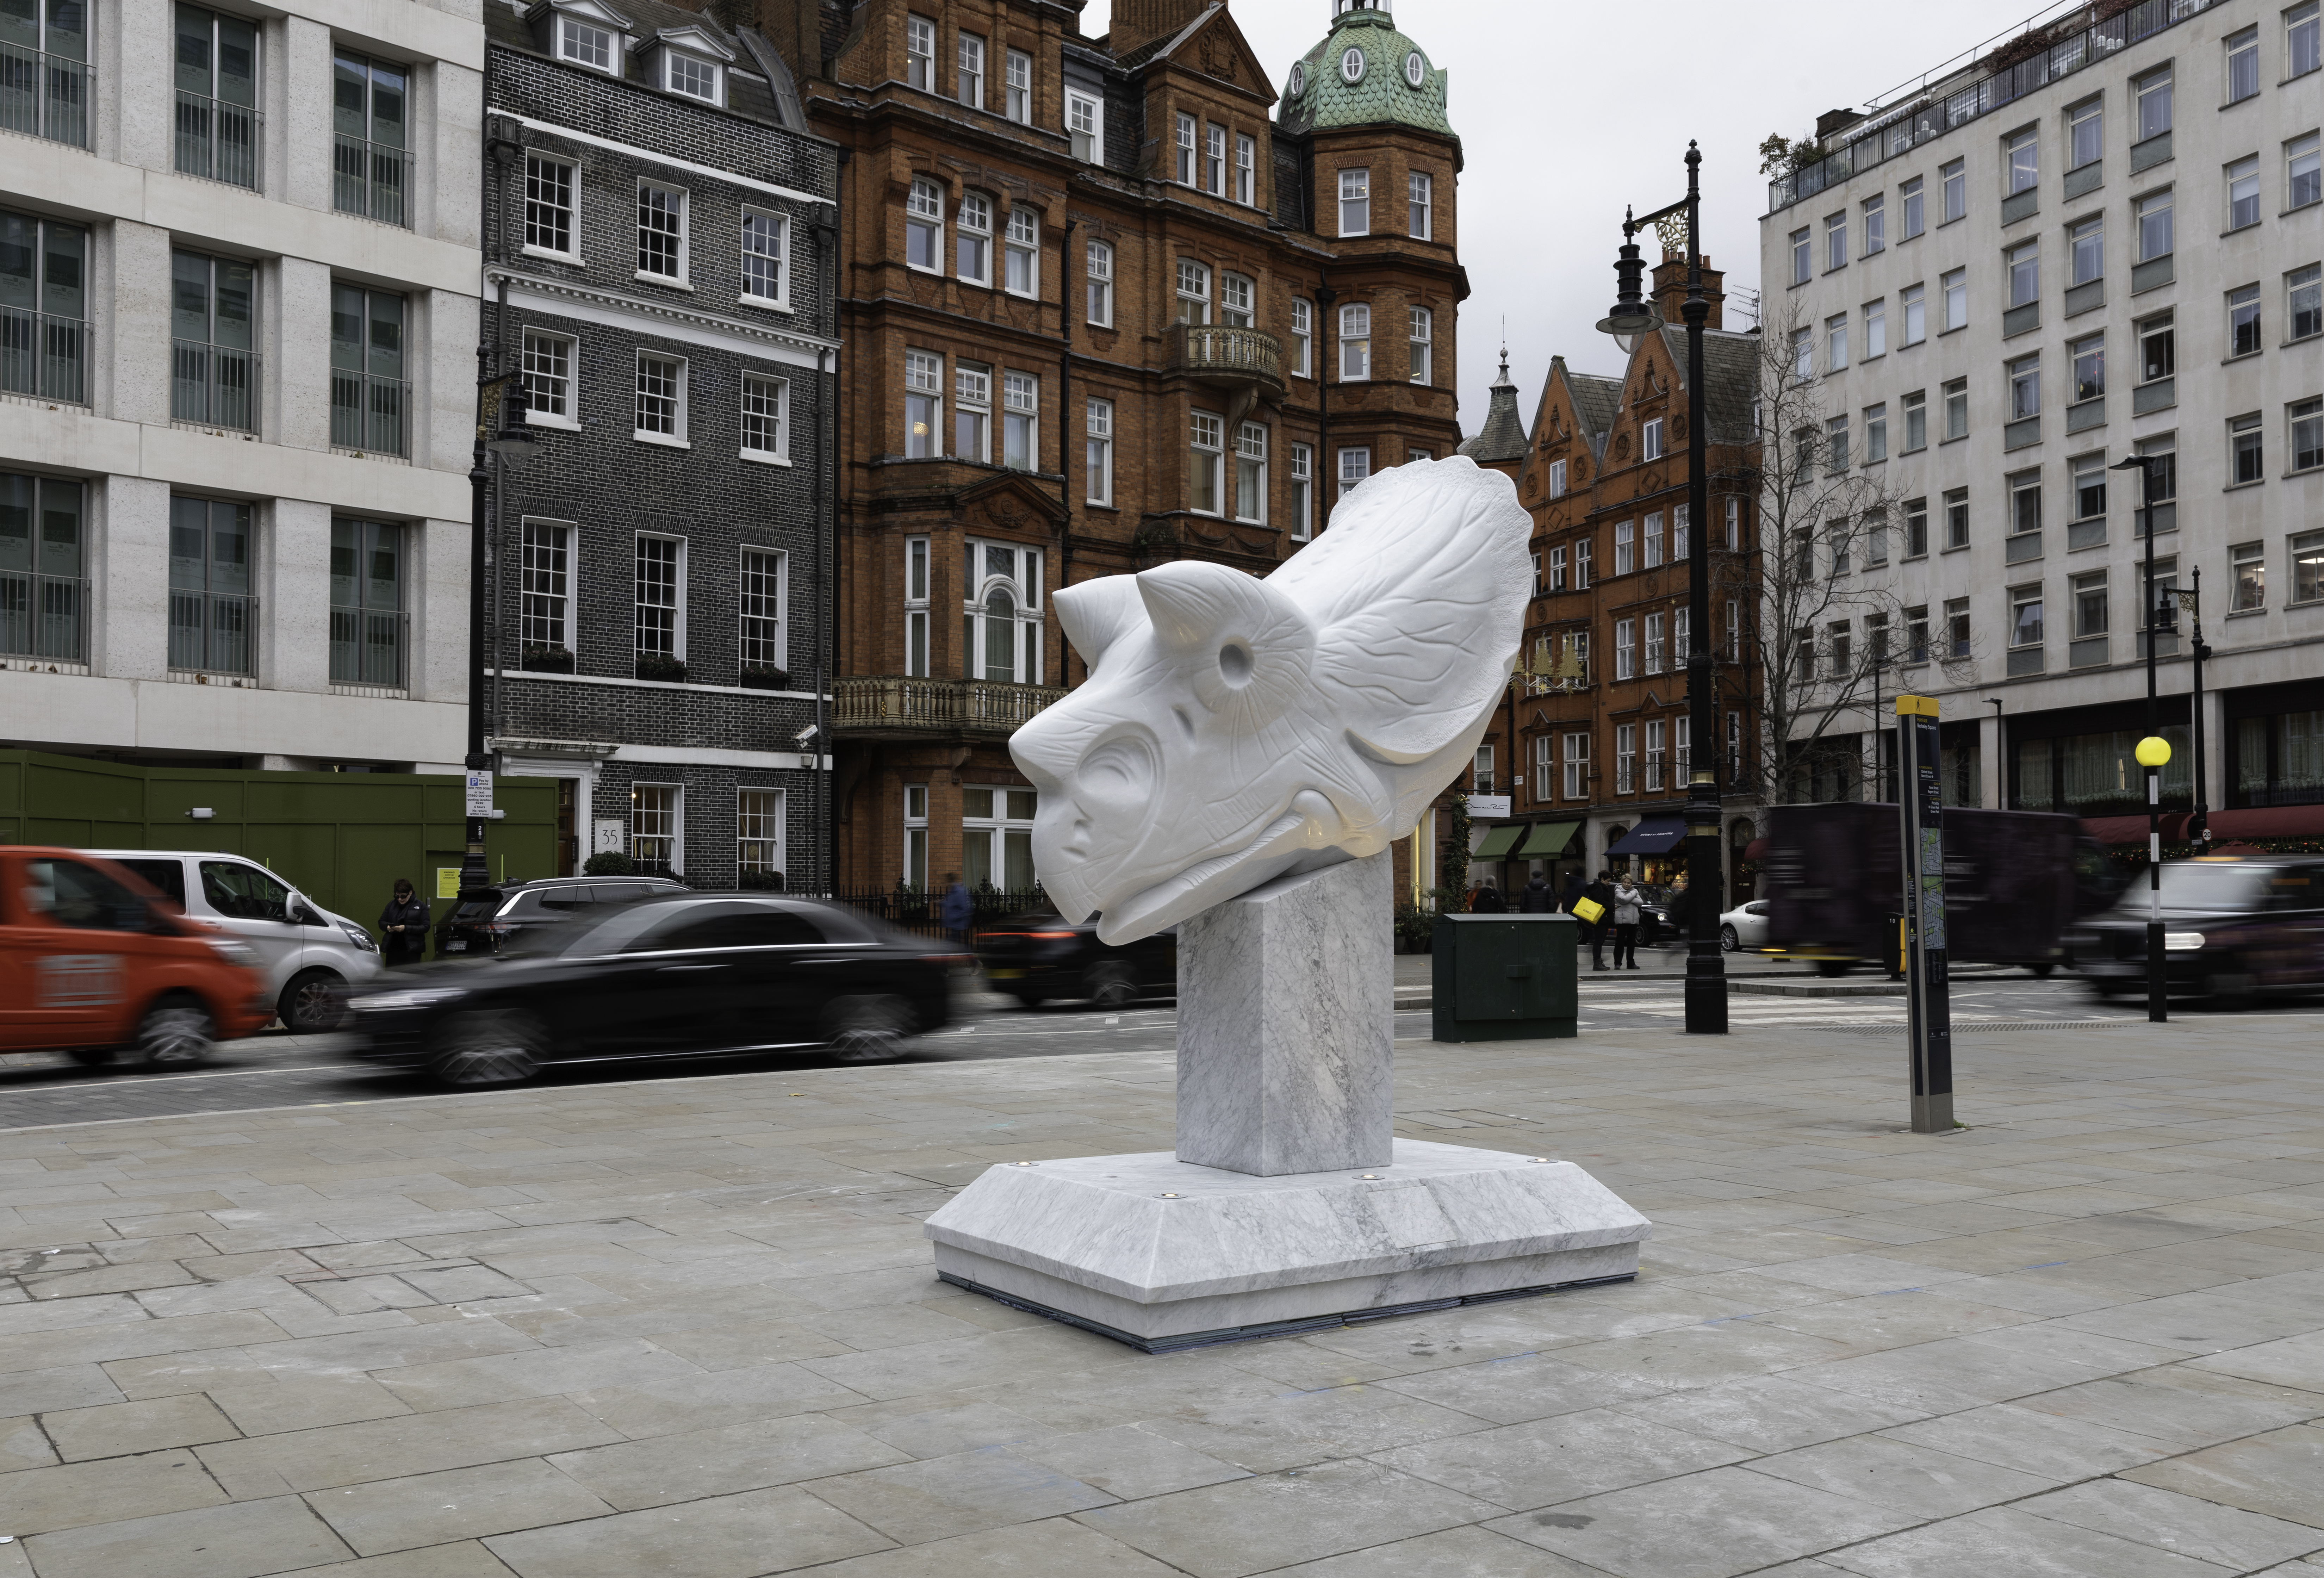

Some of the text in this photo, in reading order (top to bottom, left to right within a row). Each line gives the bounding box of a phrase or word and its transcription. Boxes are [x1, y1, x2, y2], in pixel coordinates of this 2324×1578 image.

[48, 276, 78, 287] harwood
[0, 529, 27, 538] arwood
[45, 534, 75, 542] harwood
[602, 830, 617, 845] 35
